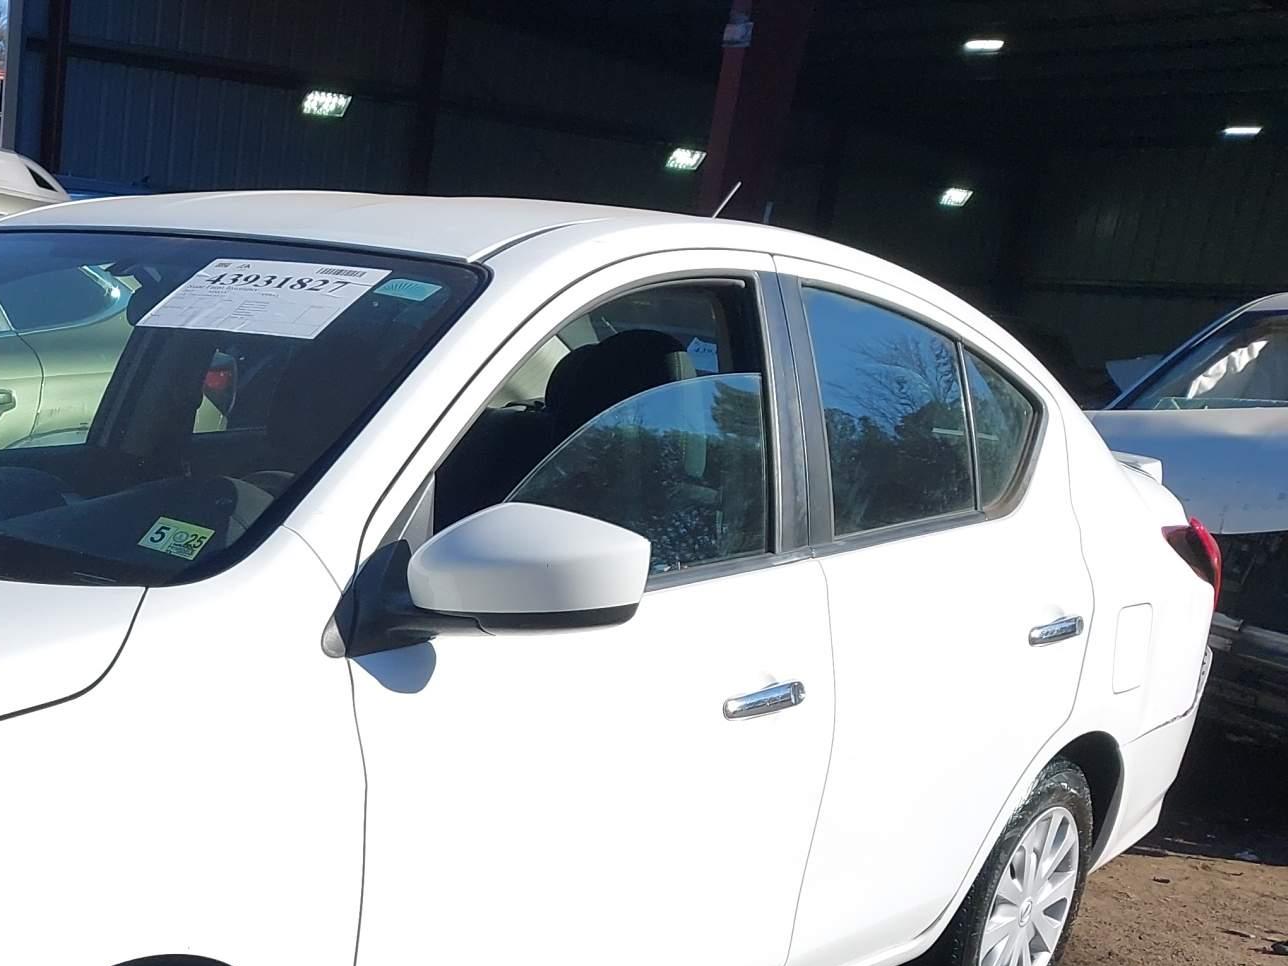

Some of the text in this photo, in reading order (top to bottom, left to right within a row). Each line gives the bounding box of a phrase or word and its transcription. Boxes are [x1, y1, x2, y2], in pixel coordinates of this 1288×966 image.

[205, 272, 351, 294] 43931827
[149, 526, 171, 543] 5
[184, 533, 207, 549] 25
